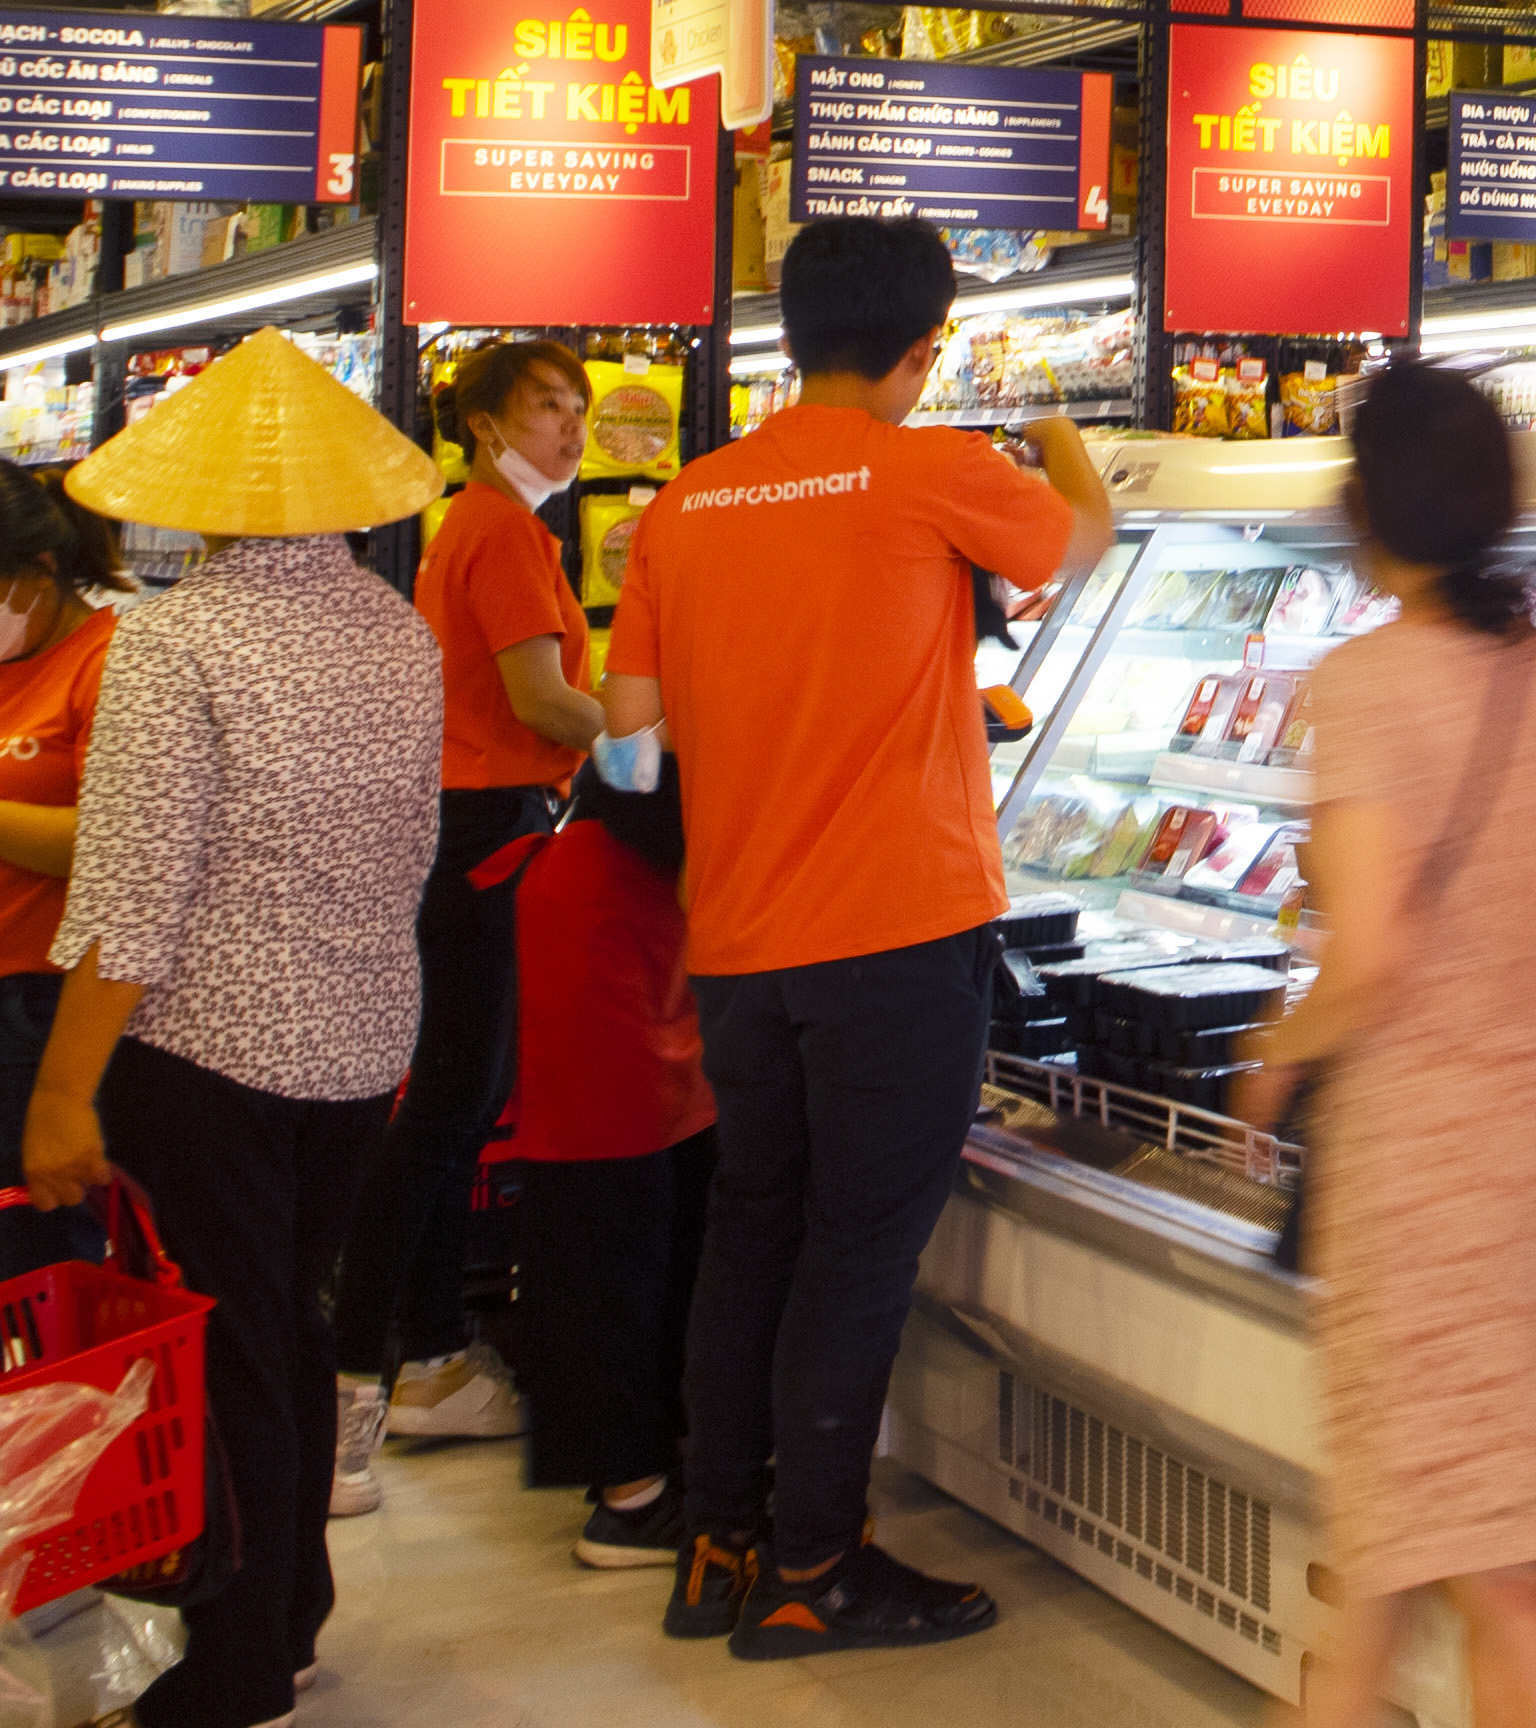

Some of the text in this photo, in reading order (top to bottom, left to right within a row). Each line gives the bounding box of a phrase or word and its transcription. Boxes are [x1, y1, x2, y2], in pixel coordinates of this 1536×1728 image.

[60, 27, 144, 47] SOCOLA
[513, 8, 628, 62] SIÊU
[687, 24, 721, 52] Chicken
[20, 56, 64, 79] CỐC
[66, 57, 98, 80] ĂN
[100, 60, 158, 84] SÁNG
[811, 66, 884, 90] MẬT ONG
[1248, 54, 1340, 102] SIÊU
[16, 94, 112, 120] CÁC LOẠI
[442, 63, 691, 135] TIẾT KIỆM
[810, 99, 999, 127] THỰC PHẨM CHỨC NĂNG
[1461, 103, 1530, 124] BIA RƯỢU
[14, 131, 111, 156] CÁC LOẠI
[809, 132, 932, 158] BÁNH CÁC LOẠI
[1192, 101, 1390, 166] TIẾT KIỆM
[1461, 130, 1487, 149] TRÀ
[1496, 131, 1514, 150] CÀ
[474, 147, 656, 170] SUPER SAVING
[1461, 158, 1498, 178] NƯỚC
[1500, 159, 1536, 180] UỐNG
[11, 168, 108, 194] CÁC LOẠI
[327, 153, 355, 196] 3
[509, 172, 621, 193] EVEYDAY
[807, 167, 864, 184] SNACK
[1218, 176, 1363, 198] SUPER SAVING
[806, 196, 915, 218] TRÁI CÂY SẤY
[1084, 185, 1109, 223] 4
[1246, 196, 1335, 218] EVEYDAY
[1460, 186, 1480, 205] ĐỒ
[1482, 188, 1519, 208] DÙNG
